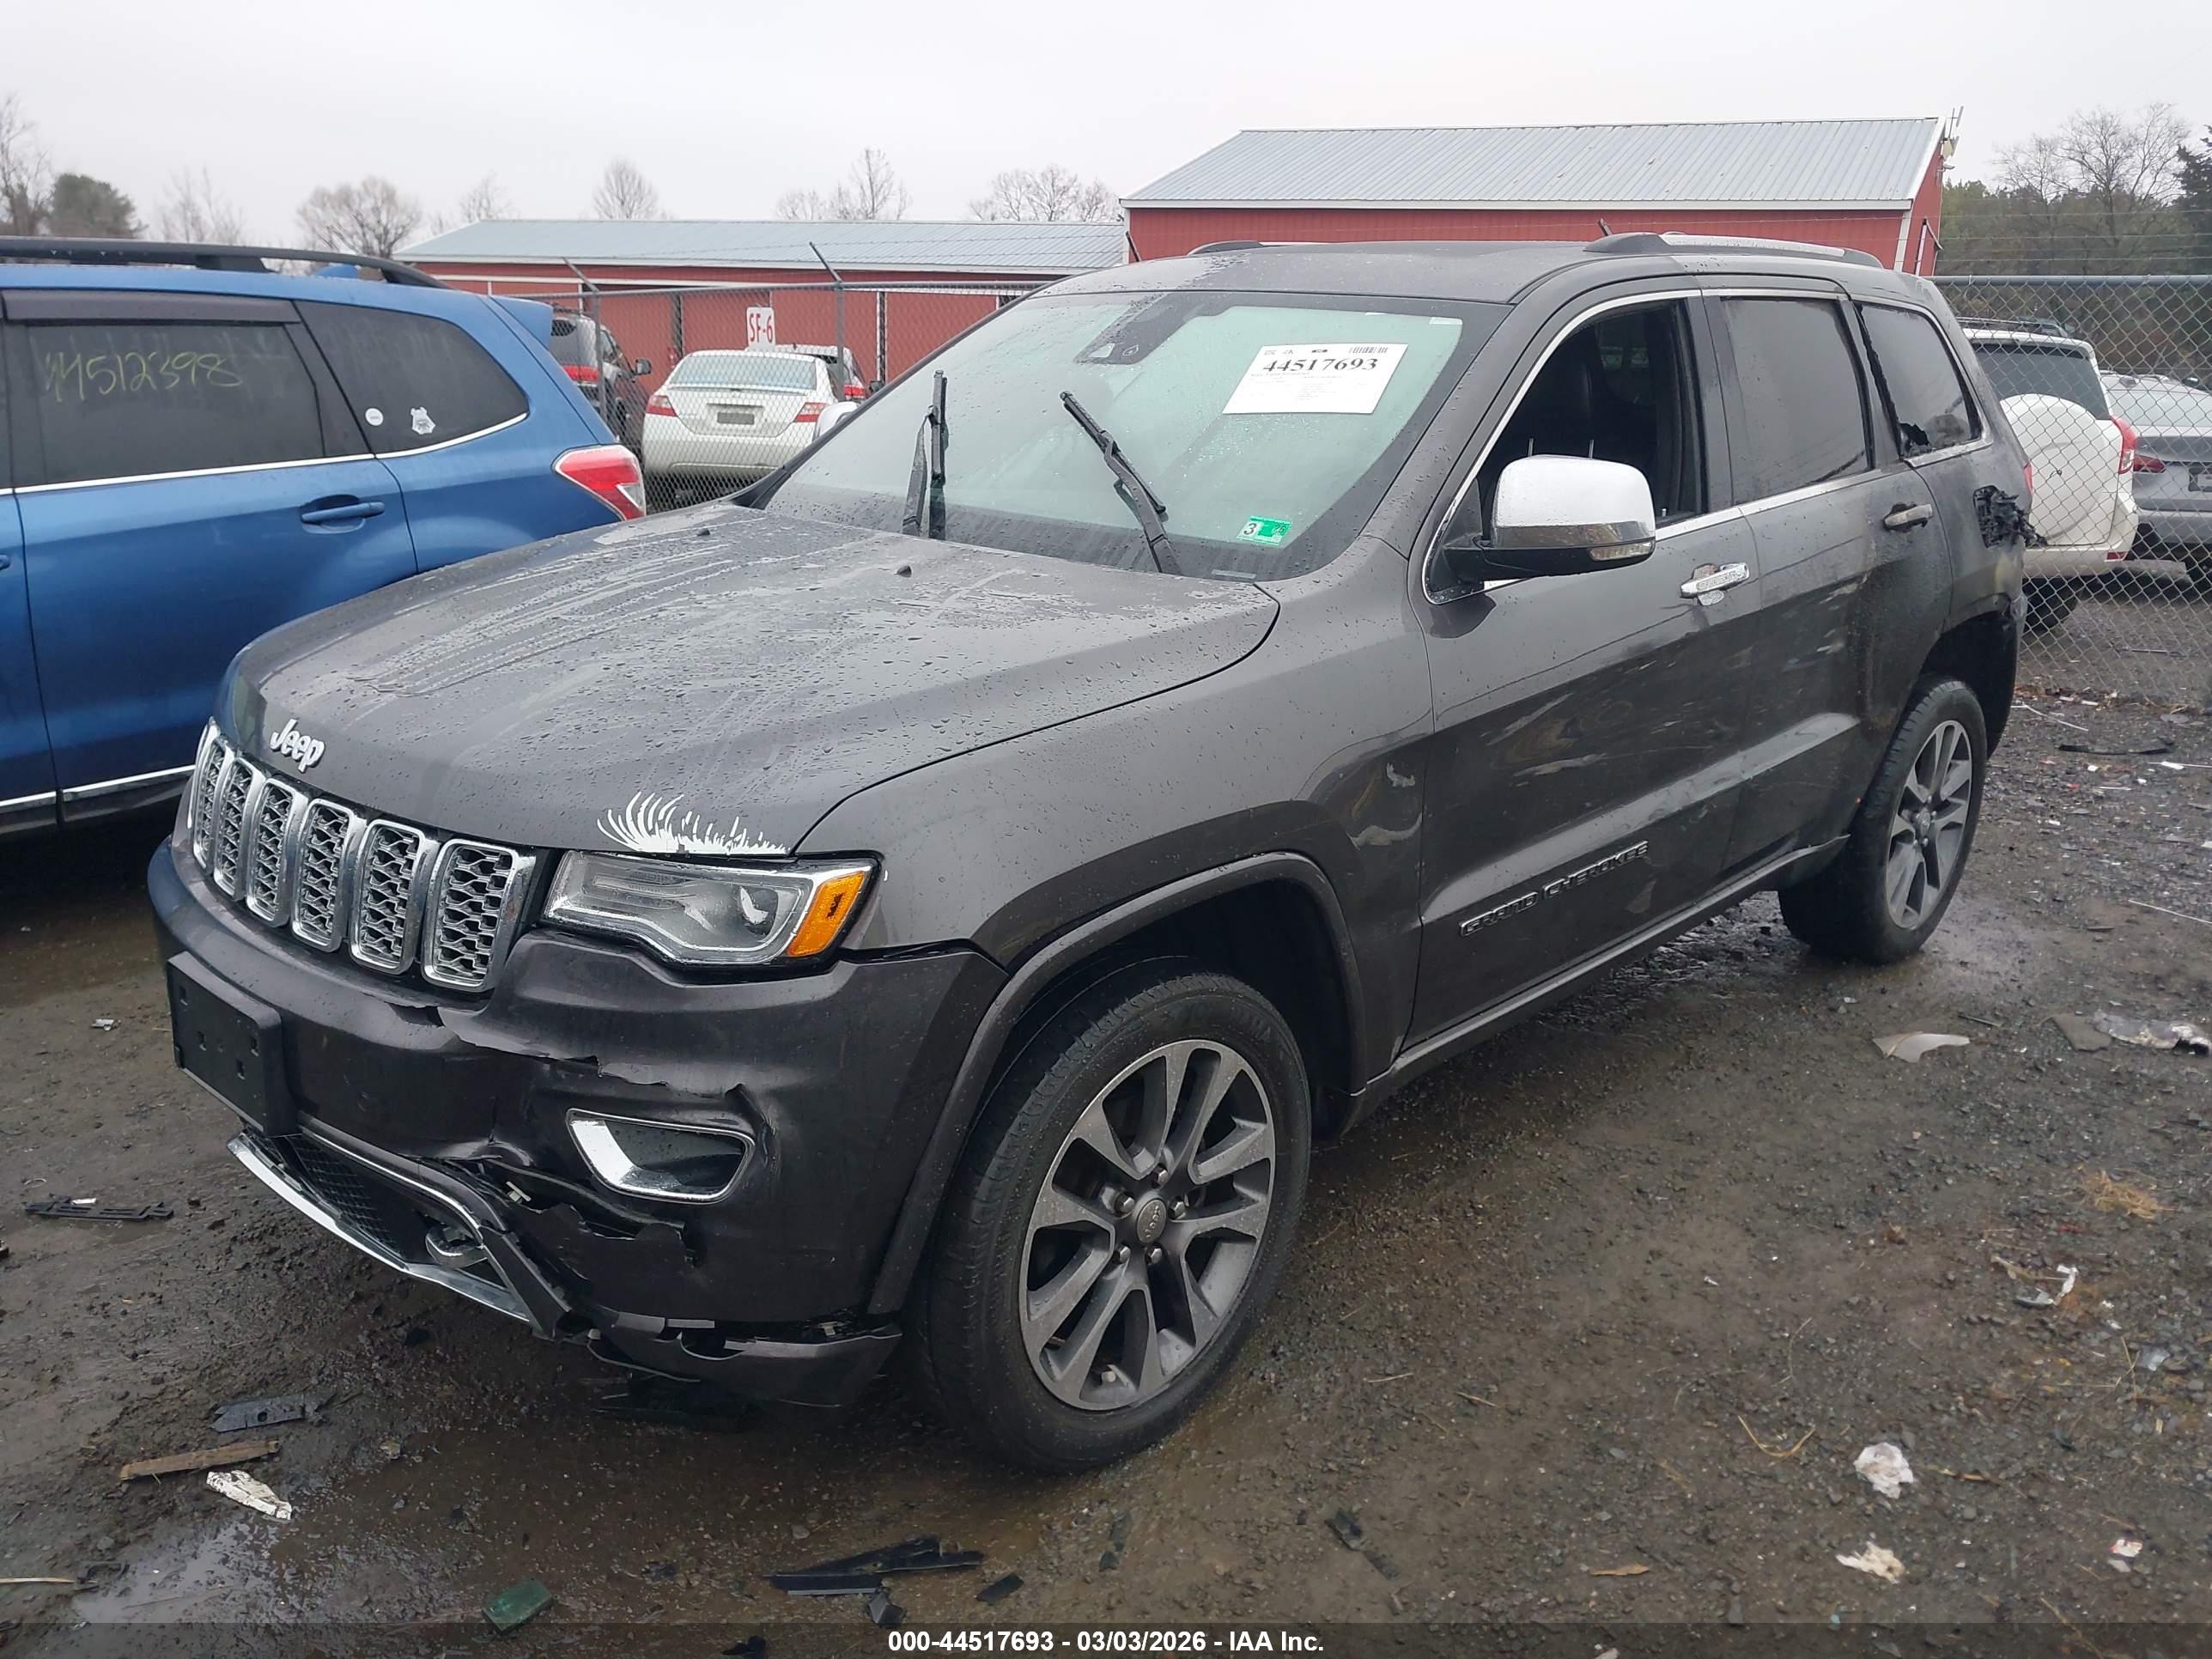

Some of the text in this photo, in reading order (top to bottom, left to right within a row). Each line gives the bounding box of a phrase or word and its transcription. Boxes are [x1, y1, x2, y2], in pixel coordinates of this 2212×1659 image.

[749, 313, 774, 343] SF-6
[1263, 358, 1378, 372] 44517693
[1243, 523, 1257, 536] 3
[269, 718, 325, 773] Jeep
[1459, 840, 1650, 936] GRAND CHEROKEE
